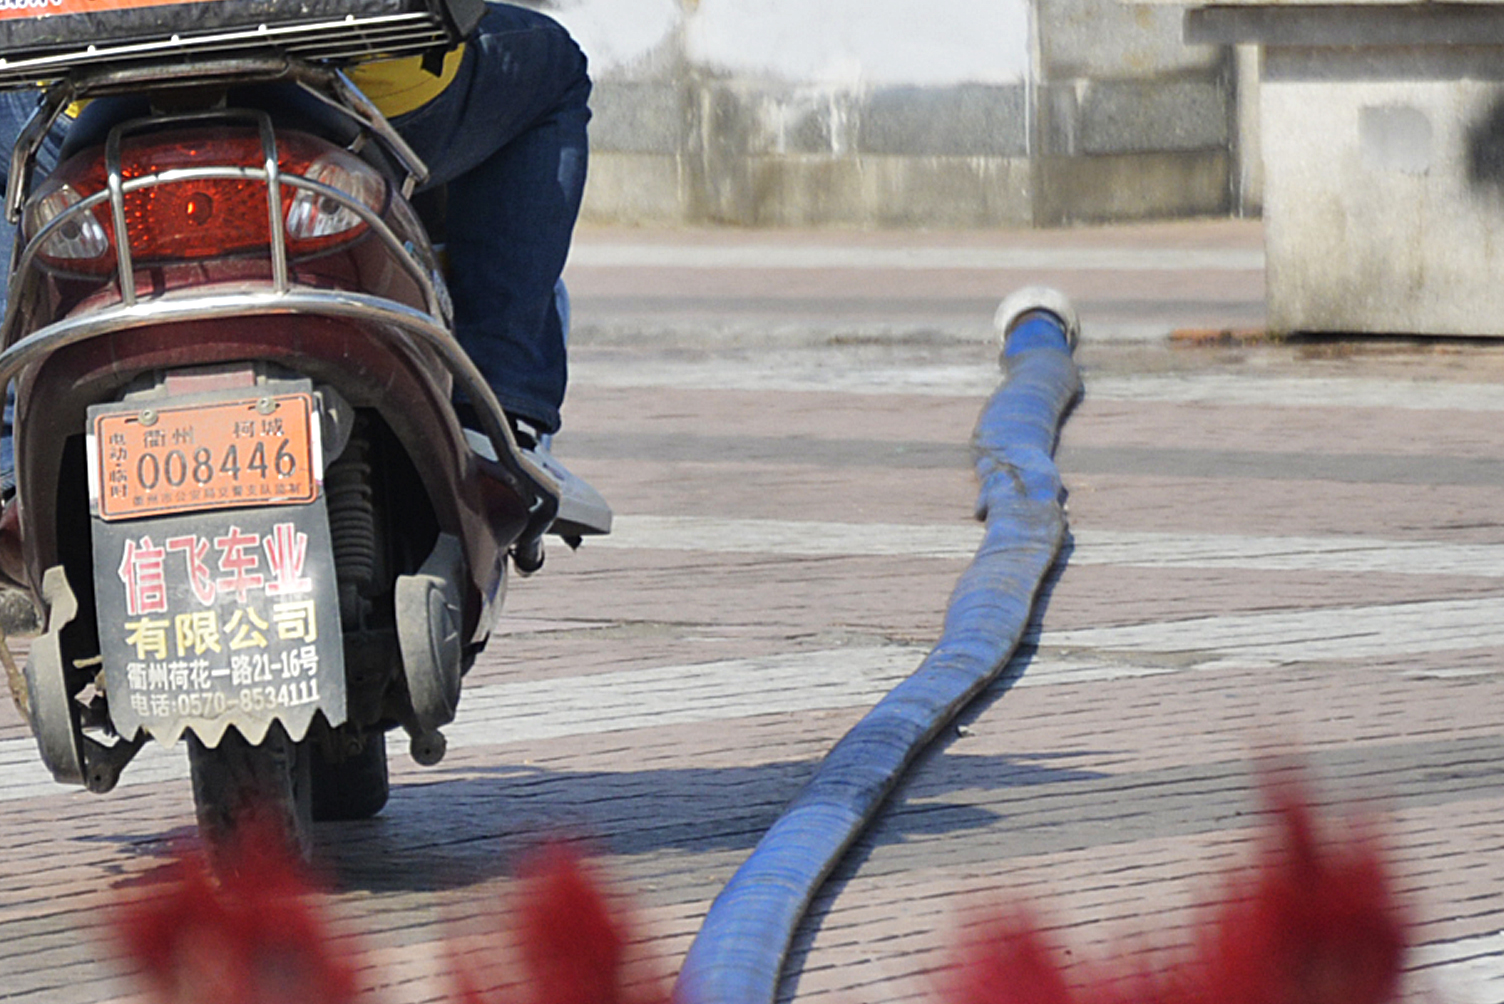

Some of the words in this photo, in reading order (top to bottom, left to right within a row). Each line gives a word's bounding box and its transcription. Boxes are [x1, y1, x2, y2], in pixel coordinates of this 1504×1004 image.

[143, 424, 195, 449] 衢州
[232, 417, 286, 439] 柯城
[136, 438, 297, 491] 008446
[118, 522, 314, 616] 信飞车业
[124, 599, 318, 660] 有限公司
[126, 645, 320, 692] 衢州荷花一路21-16号
